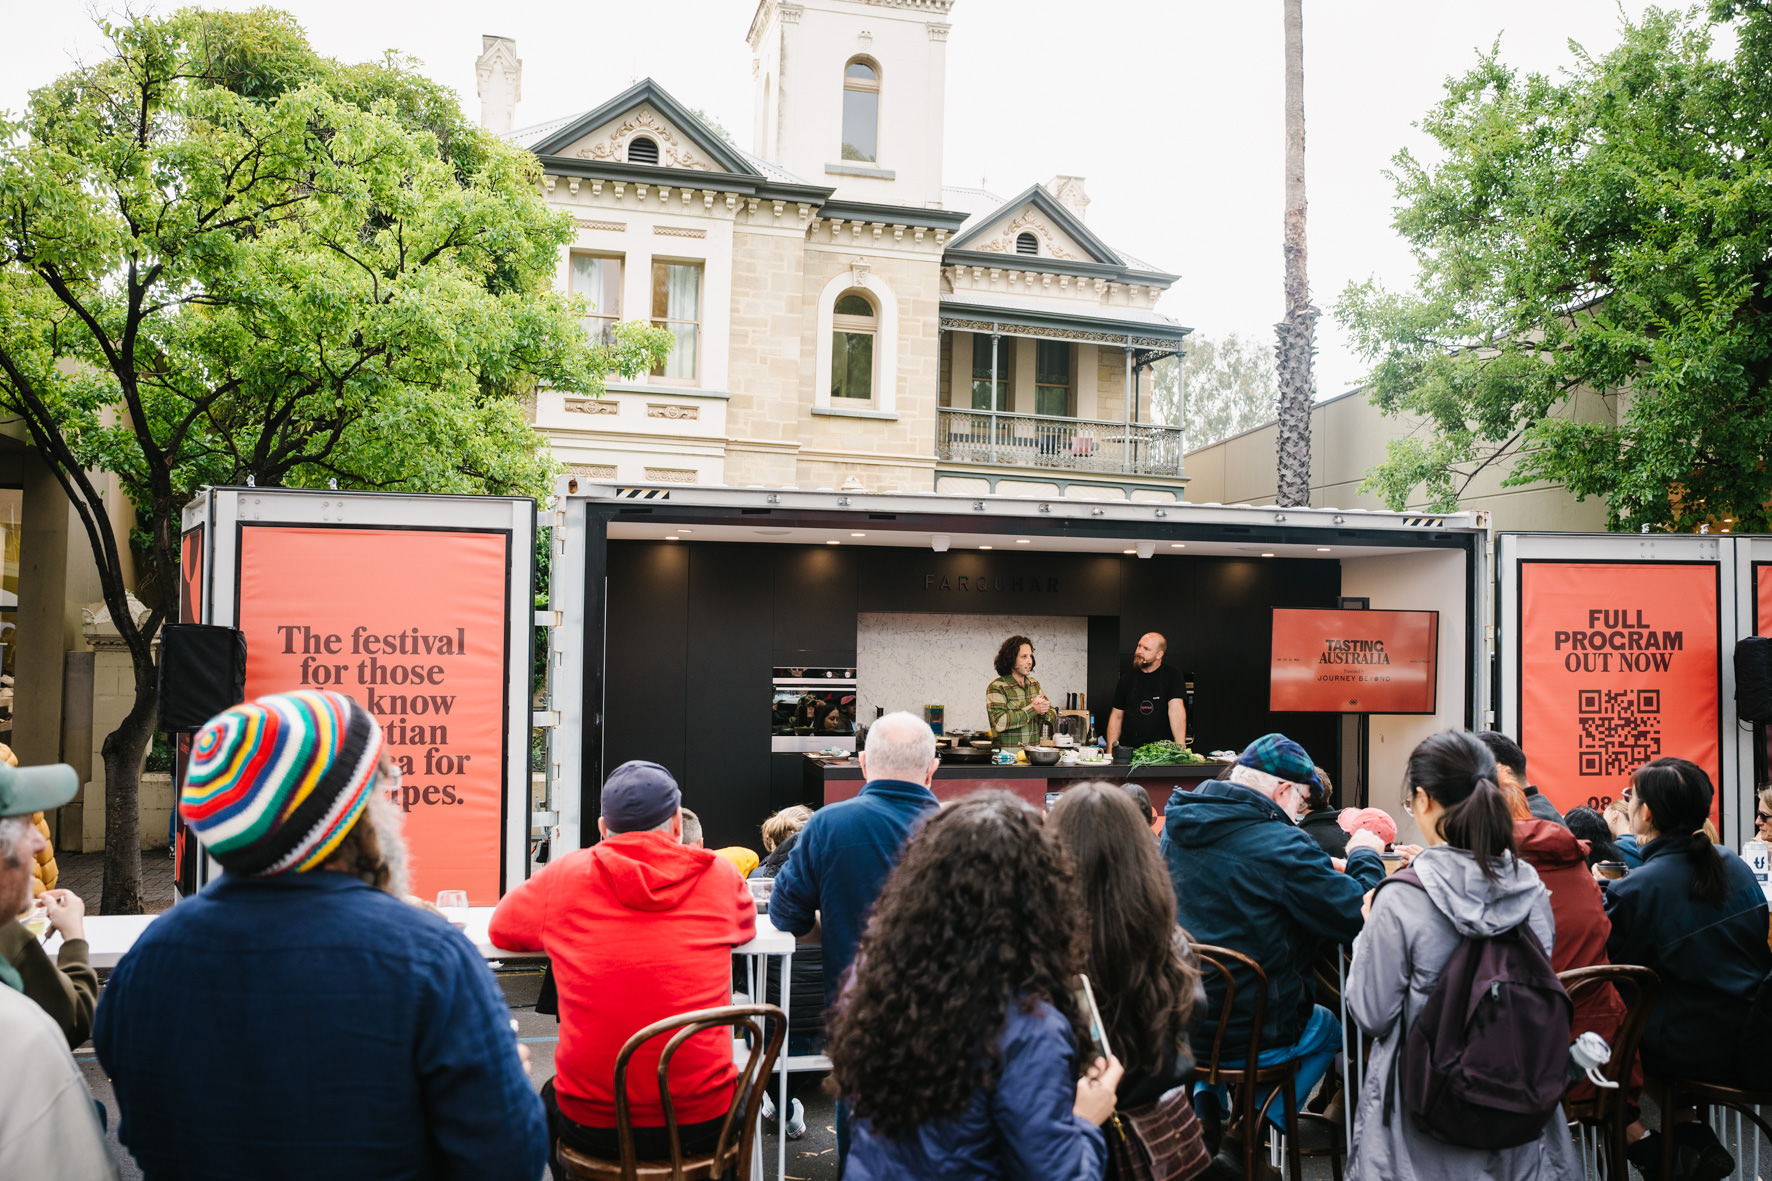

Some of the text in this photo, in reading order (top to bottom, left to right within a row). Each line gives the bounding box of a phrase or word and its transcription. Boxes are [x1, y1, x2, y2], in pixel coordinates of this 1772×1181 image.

[924, 574, 1059, 592] FARQUHAR
[1589, 609, 1650, 629] FULL
[278, 625, 466, 655] The festival
[1325, 639, 1384, 652] TASTING
[1554, 631, 1683, 651] PROGRAM
[1319, 651, 1390, 665] AUSTRALIA
[1565, 652, 1673, 672] OUT NOW
[300, 656, 445, 685] for those
[367, 687, 456, 715] know
[424, 747, 471, 775] for
